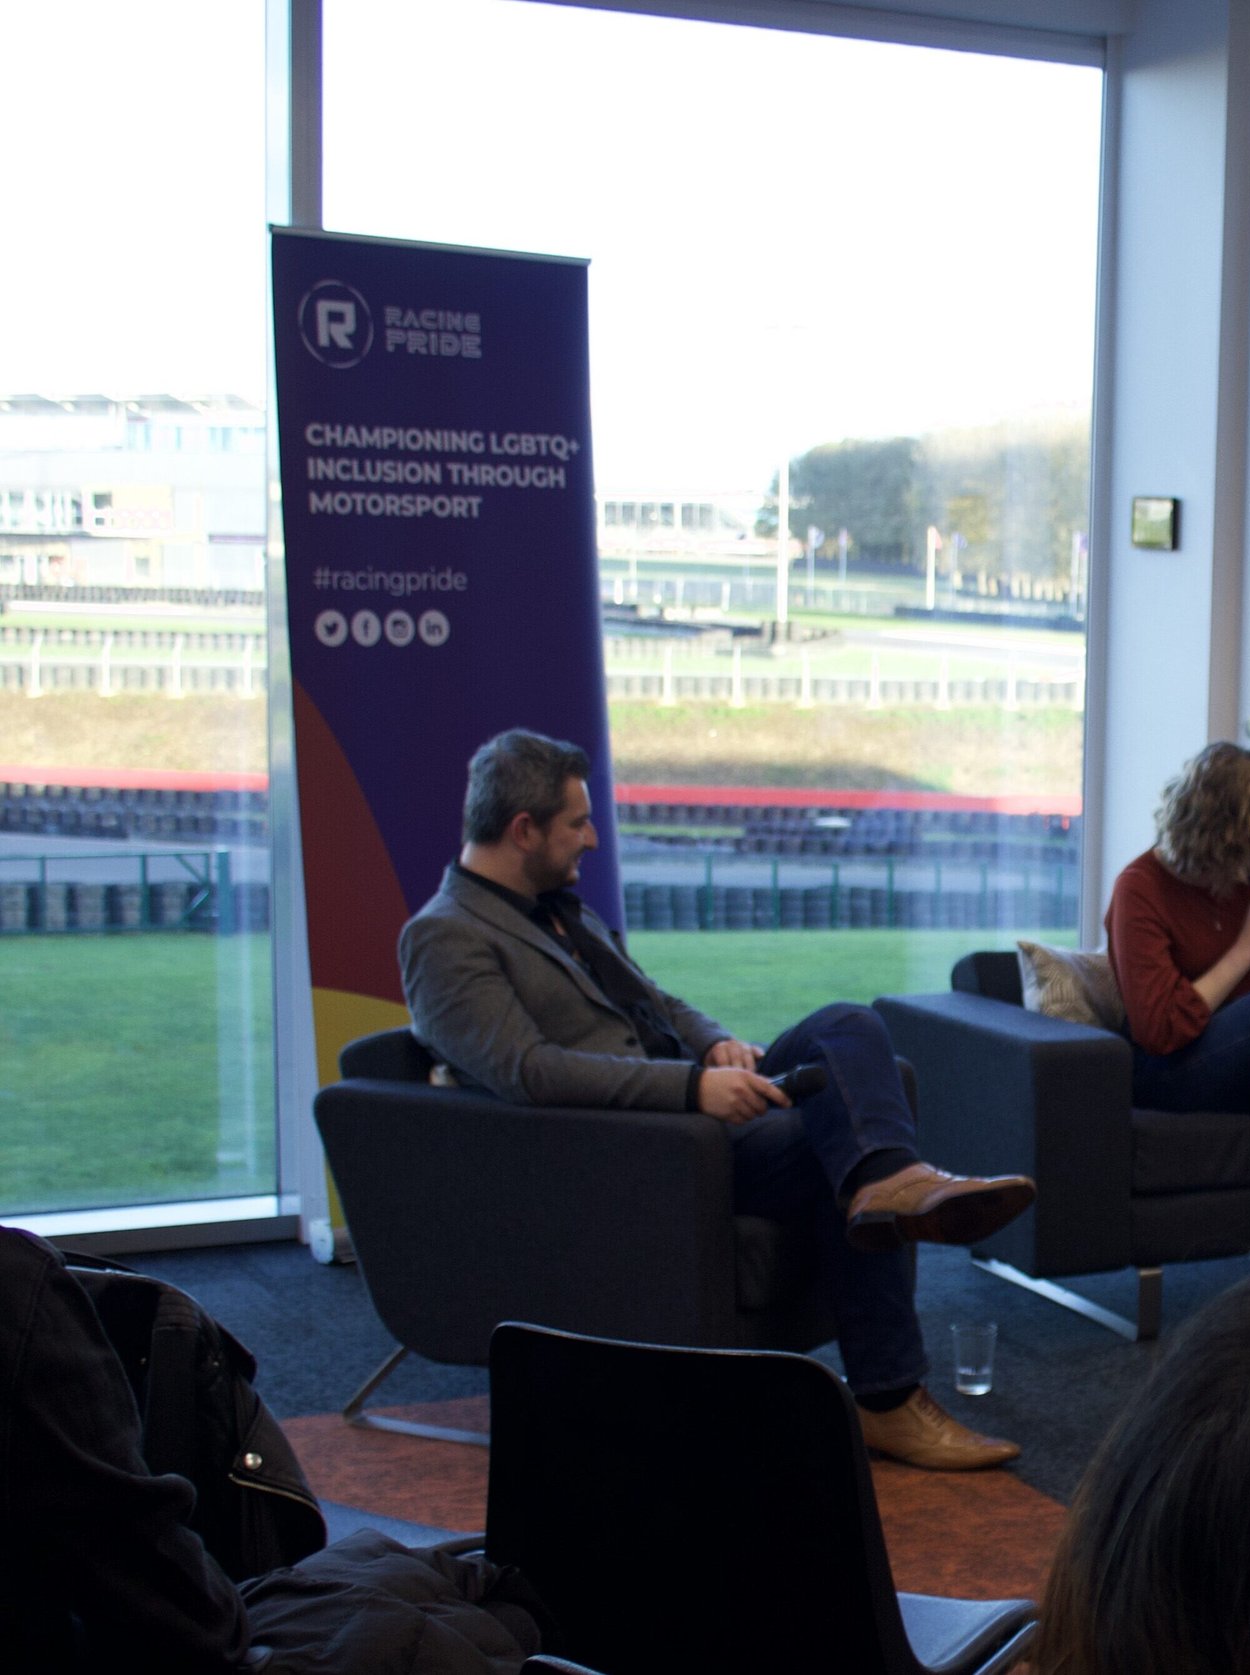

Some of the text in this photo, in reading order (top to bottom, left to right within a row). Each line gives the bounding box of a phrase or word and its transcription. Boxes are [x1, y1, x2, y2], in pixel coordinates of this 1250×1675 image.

[316, 300, 357, 349] R
[384, 306, 481, 332] RACING
[385, 328, 482, 359] PRIDE
[306, 422, 581, 461] CHAMPIONING LGBTQ+
[307, 457, 566, 488] INCLUSION THROUGH
[309, 491, 482, 519] MOTORSPORT
[313, 566, 468, 595] #racingpride
